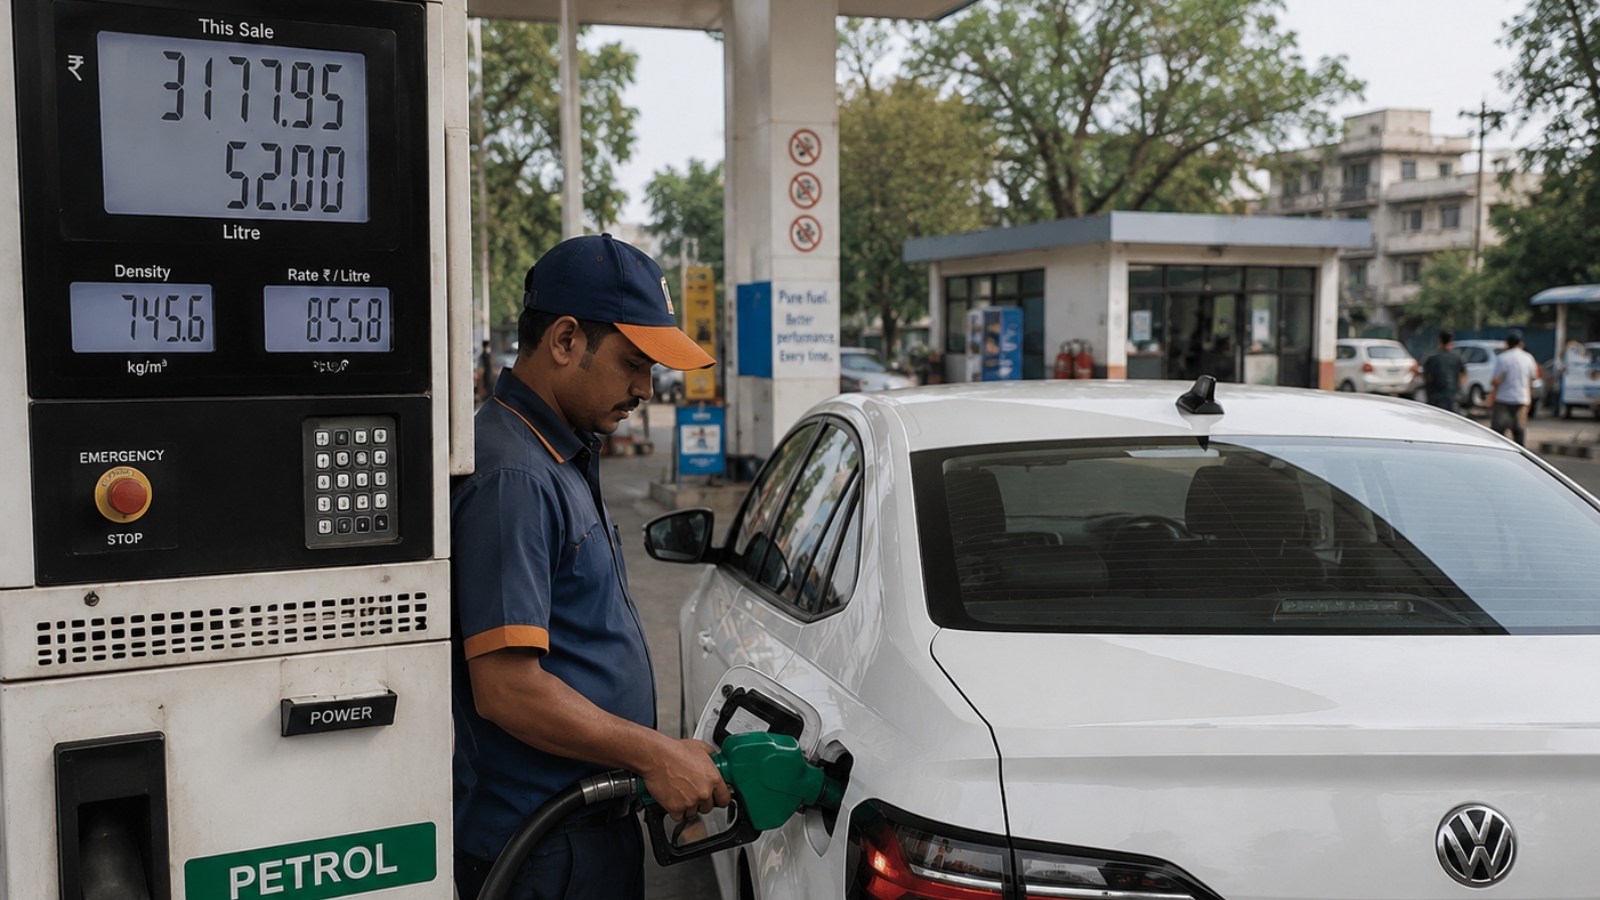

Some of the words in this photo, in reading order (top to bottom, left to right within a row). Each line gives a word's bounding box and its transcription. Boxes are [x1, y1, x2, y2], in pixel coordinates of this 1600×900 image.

[198, 18, 234, 36] This
[239, 21, 275, 39] Sale
[161, 50, 344, 131] 3177.95
[225, 140, 346, 214] 52.00
[223, 224, 261, 241] Litre
[114, 264, 171, 282] Density
[288, 268, 319, 282] Rate
[121, 294, 205, 343] 745.6
[306, 297, 383, 343] 85.58
[79, 449, 165, 464] EMERGENCY
[107, 532, 143, 545] STOP
[310, 706, 373, 725] POWER
[229, 843, 398, 900] PETROL
